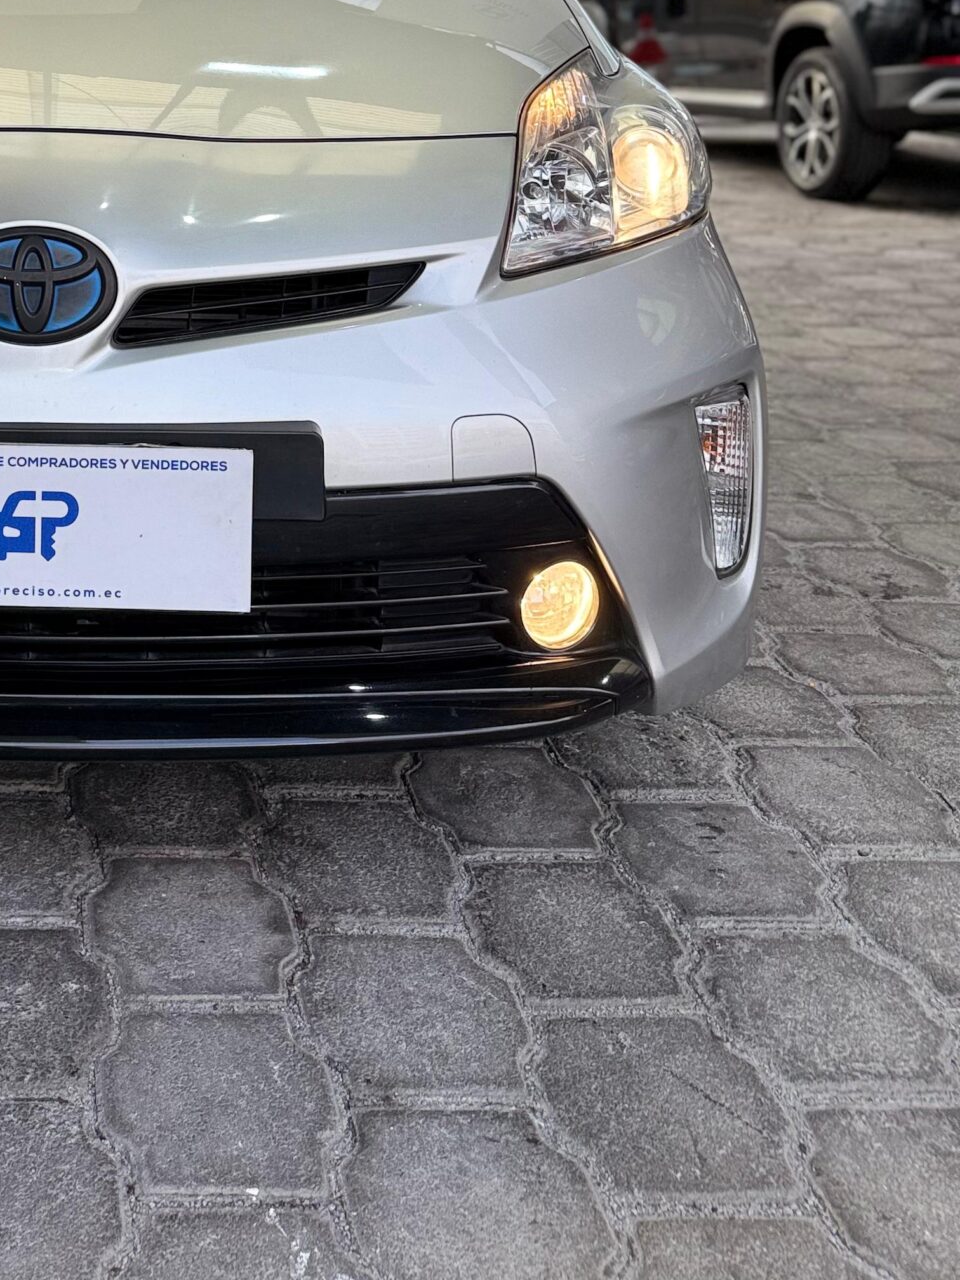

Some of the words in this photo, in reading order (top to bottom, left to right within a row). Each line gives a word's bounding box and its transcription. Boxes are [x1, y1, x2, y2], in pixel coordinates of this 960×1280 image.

[7, 456, 117, 469] COMPRADORES
[119, 458, 129, 469] Y
[131, 459, 228, 472] VENDEDORES
